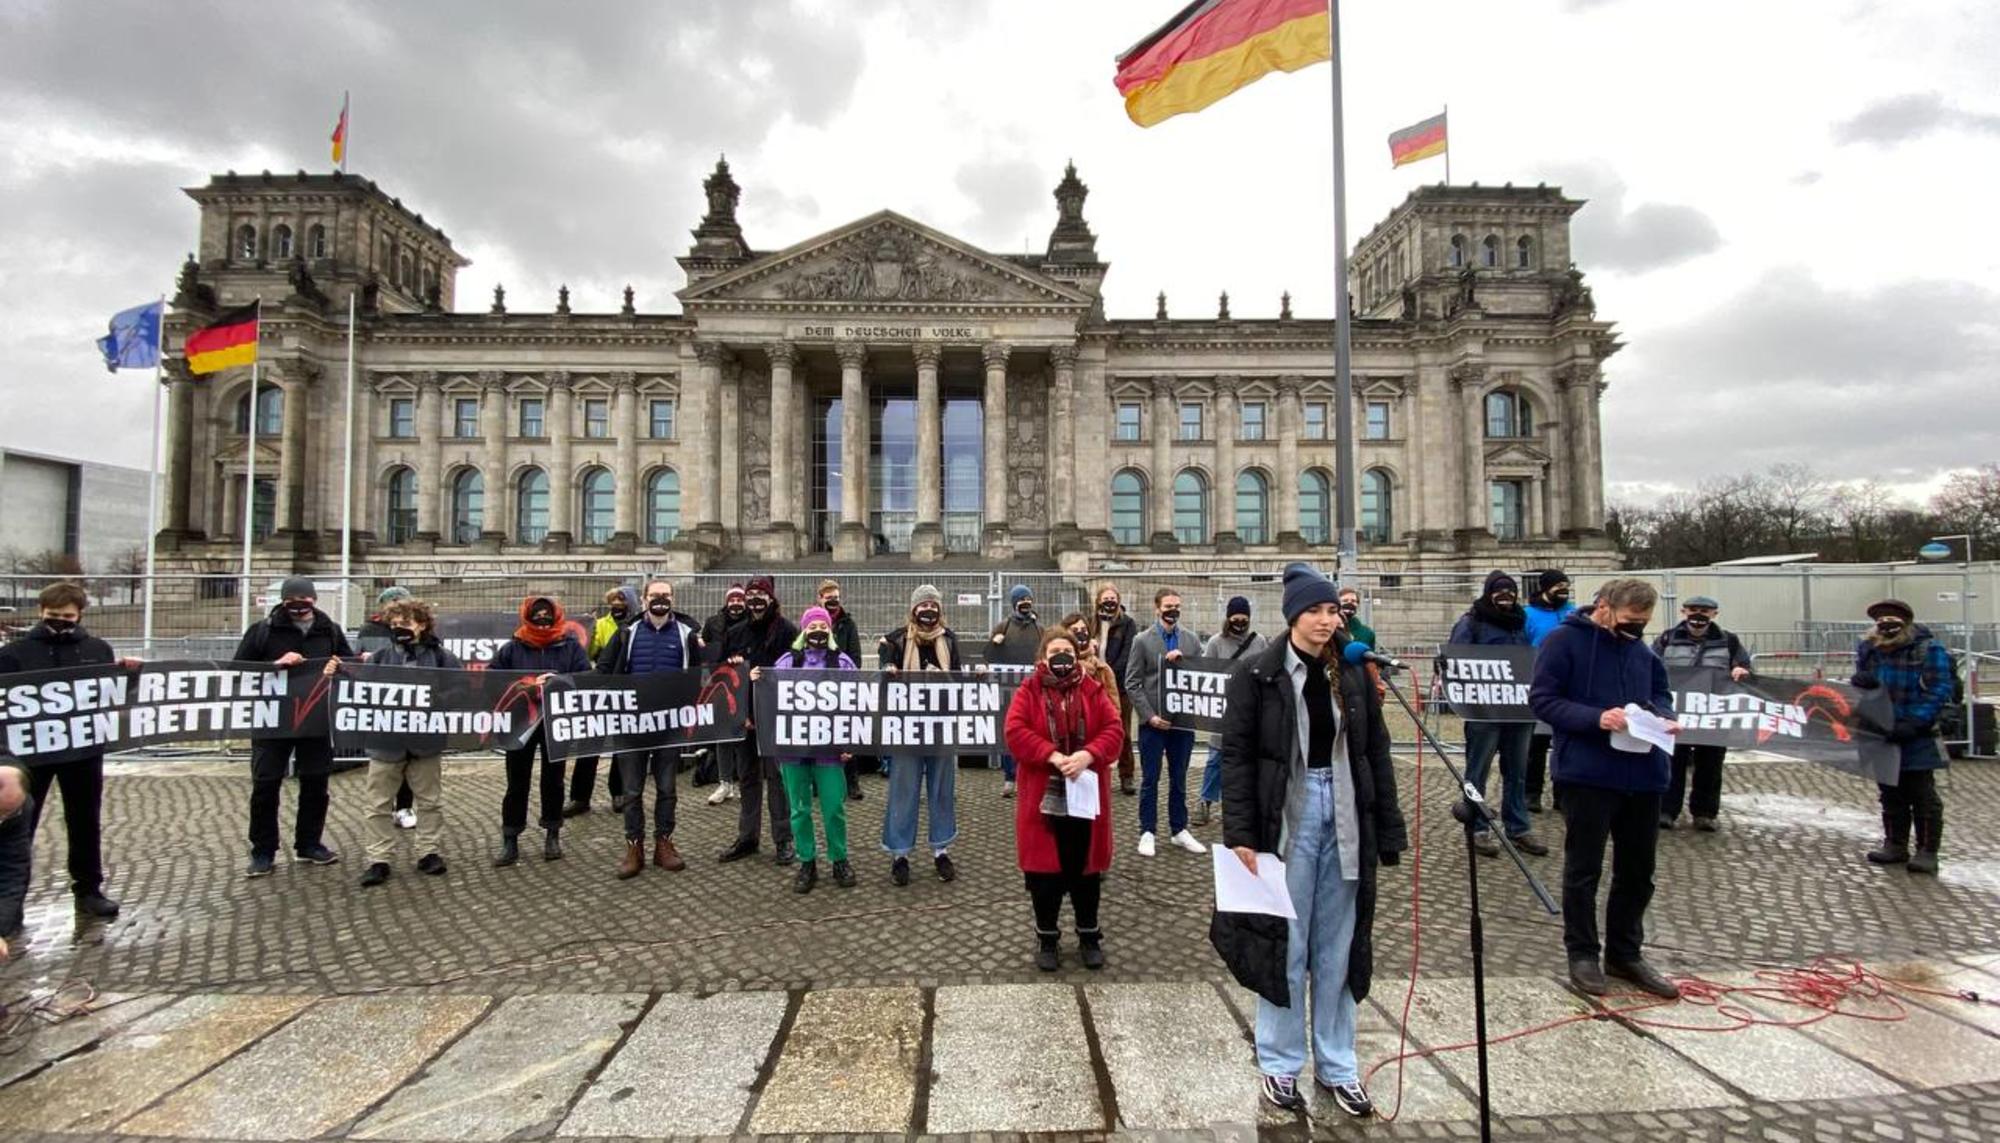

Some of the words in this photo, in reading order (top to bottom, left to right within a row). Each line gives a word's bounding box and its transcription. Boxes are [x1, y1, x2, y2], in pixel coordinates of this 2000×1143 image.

[805, 326, 835, 336] DEM
[845, 327, 921, 337] DEUTSCHEN
[932, 327, 973, 338] VOLKE
[1446, 658, 1514, 680] LETZTE
[0, 676, 128, 720] SSEN
[138, 670, 288, 703] RETTEN
[338, 680, 431, 708] LETZTE
[550, 690, 638, 715] LETZTE
[777, 680, 879, 711] ESSEN
[887, 682, 1000, 711] RETTEN
[1685, 691, 1808, 724] RETTEN
[129, 700, 280, 738] RETTEN
[335, 706, 512, 734] GENERATION
[552, 703, 714, 742] GENERATION
[775, 714, 873, 745] LEBEN
[881, 715, 996, 745] RETTEN
[1678, 712, 1803, 738] RETTEN
